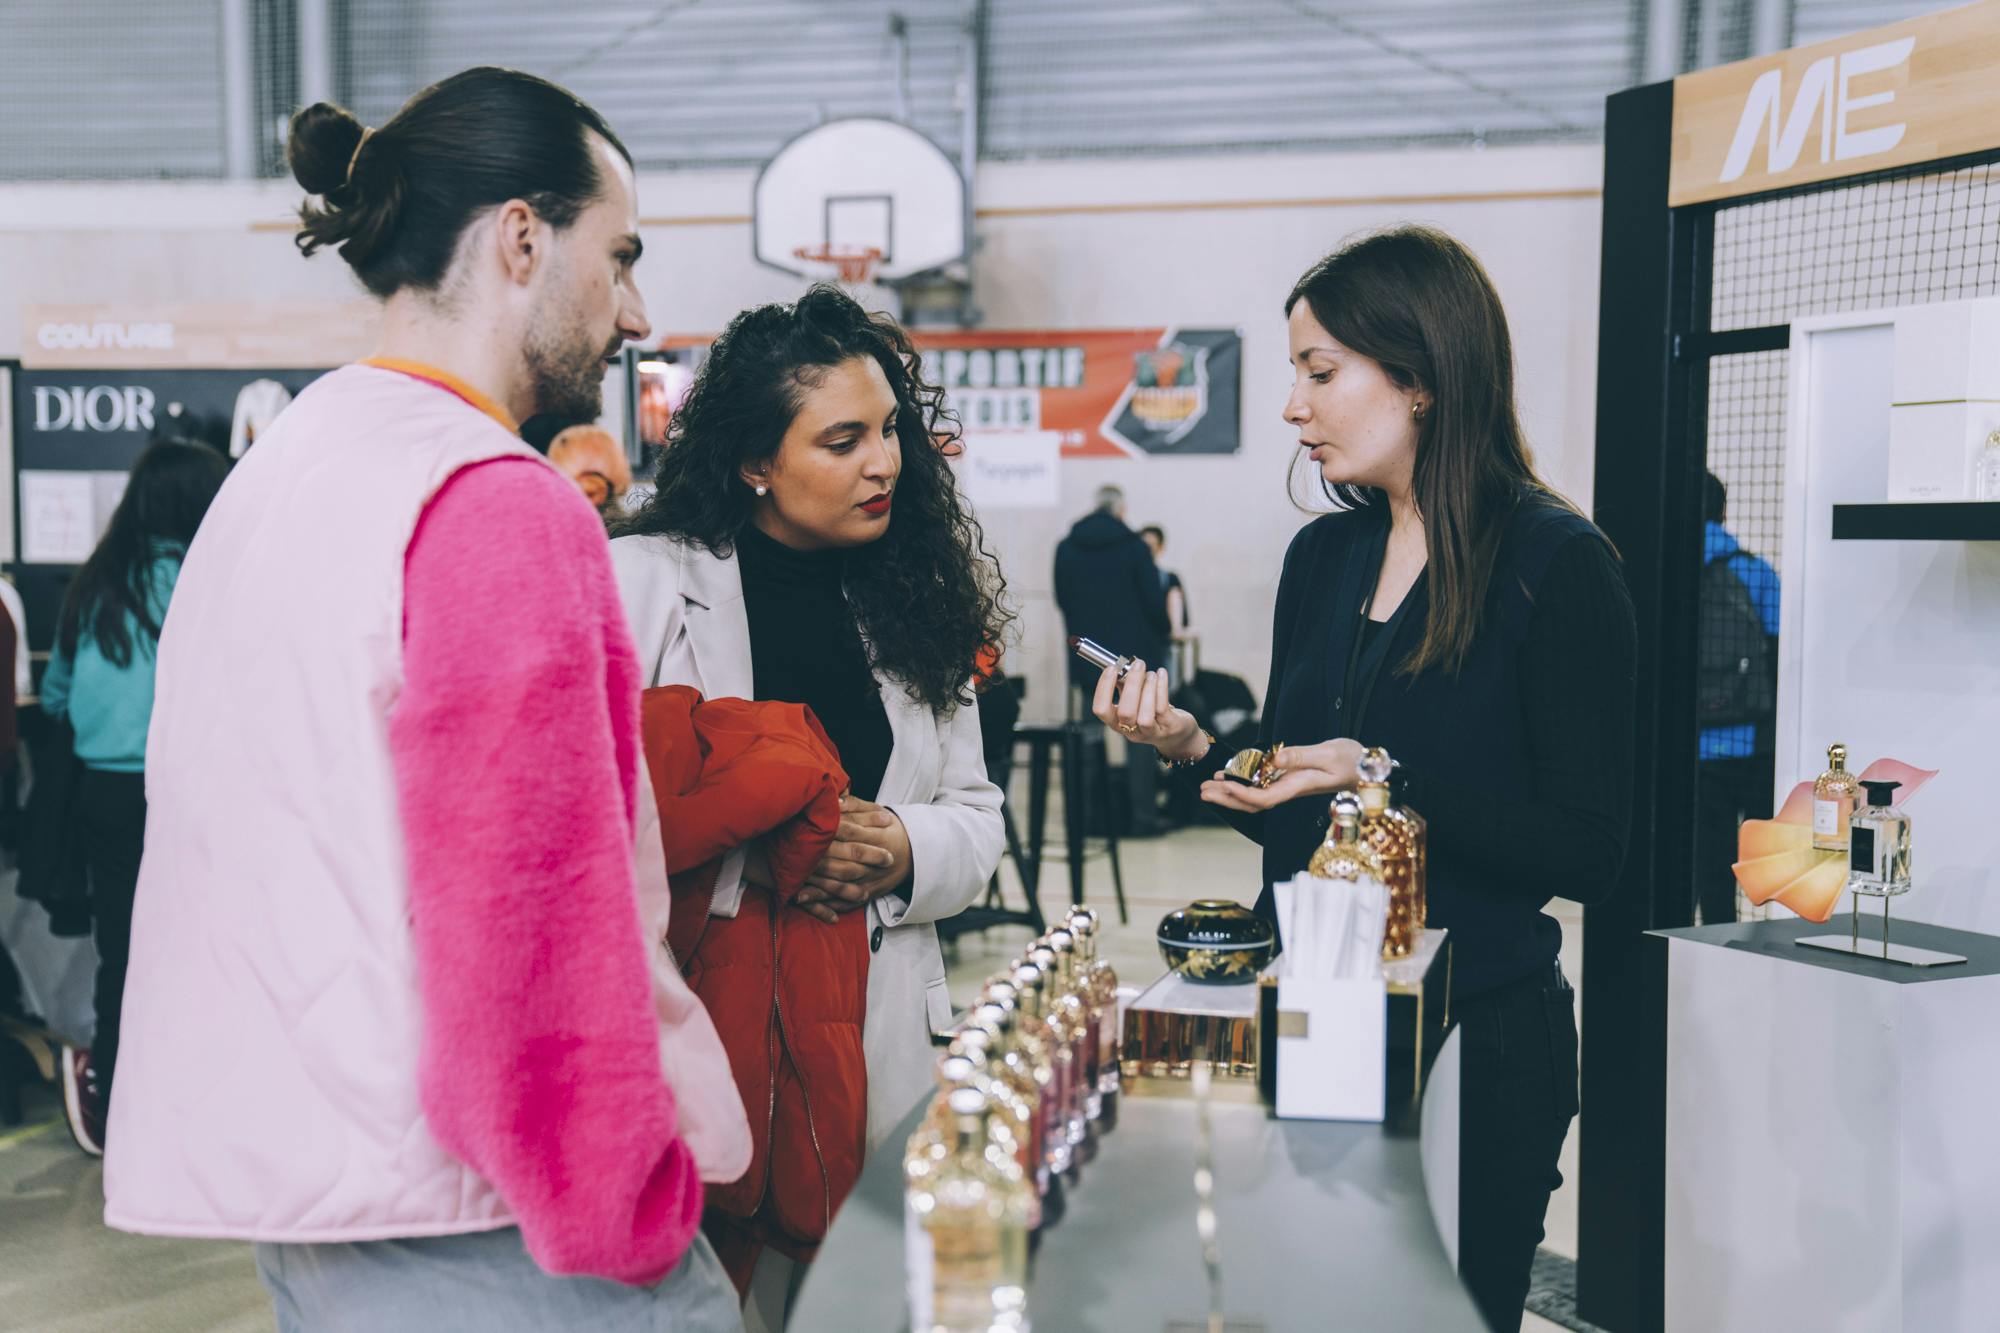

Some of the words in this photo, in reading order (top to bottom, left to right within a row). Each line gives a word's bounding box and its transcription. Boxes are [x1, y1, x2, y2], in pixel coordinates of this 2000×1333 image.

[1720, 36, 1916, 183] ME
[37, 322, 175, 349] COUTURE
[33, 385, 156, 432] DIOR
